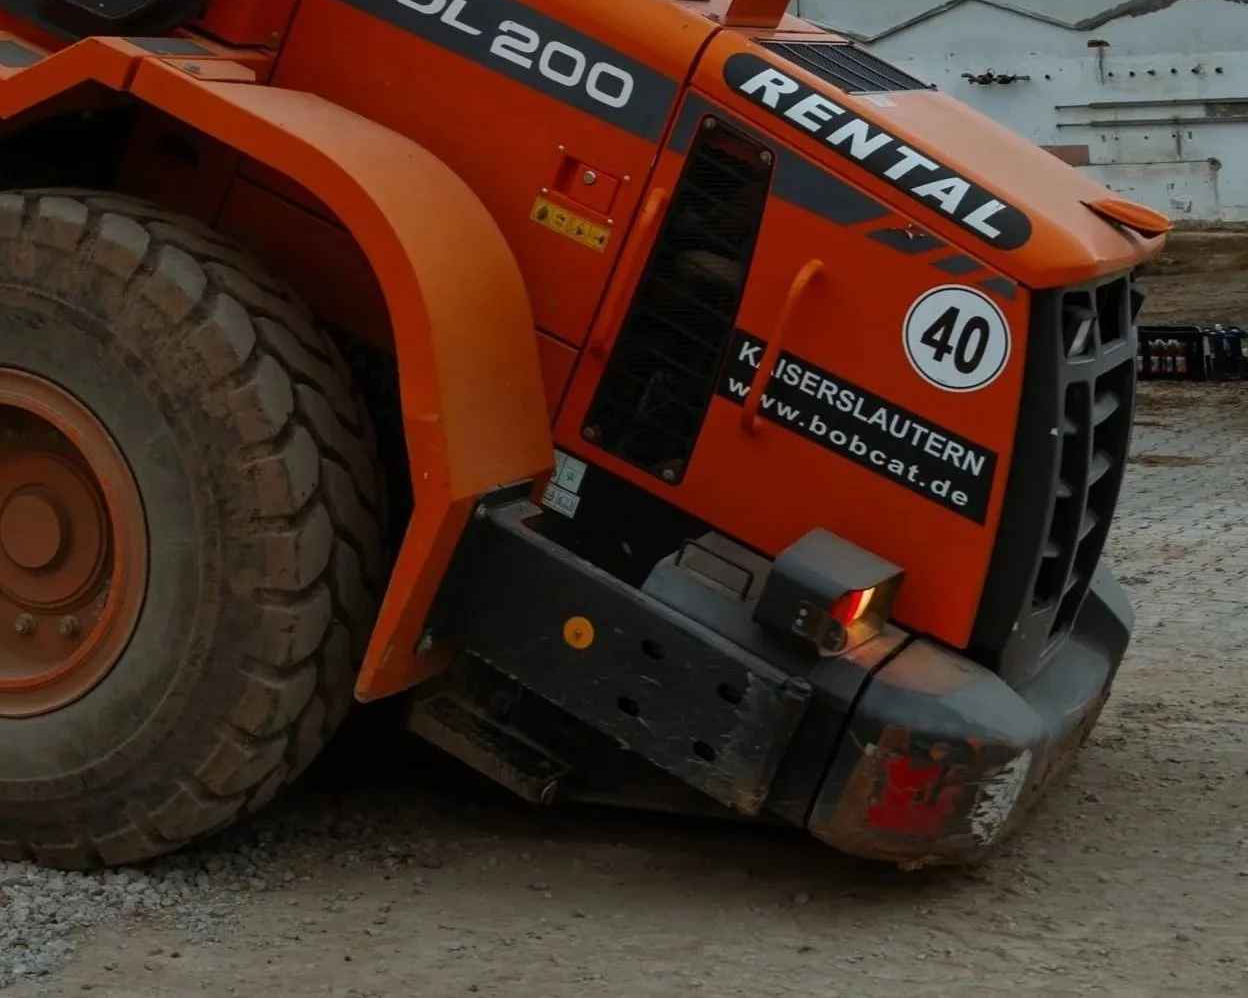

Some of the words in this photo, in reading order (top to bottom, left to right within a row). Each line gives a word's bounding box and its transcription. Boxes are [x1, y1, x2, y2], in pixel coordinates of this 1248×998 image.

[490, 19, 634, 109] 200
[739, 67, 1007, 239] RENTAL
[920, 306, 991, 374] 40
[738, 341, 986, 477] KISERSLAUTERN
